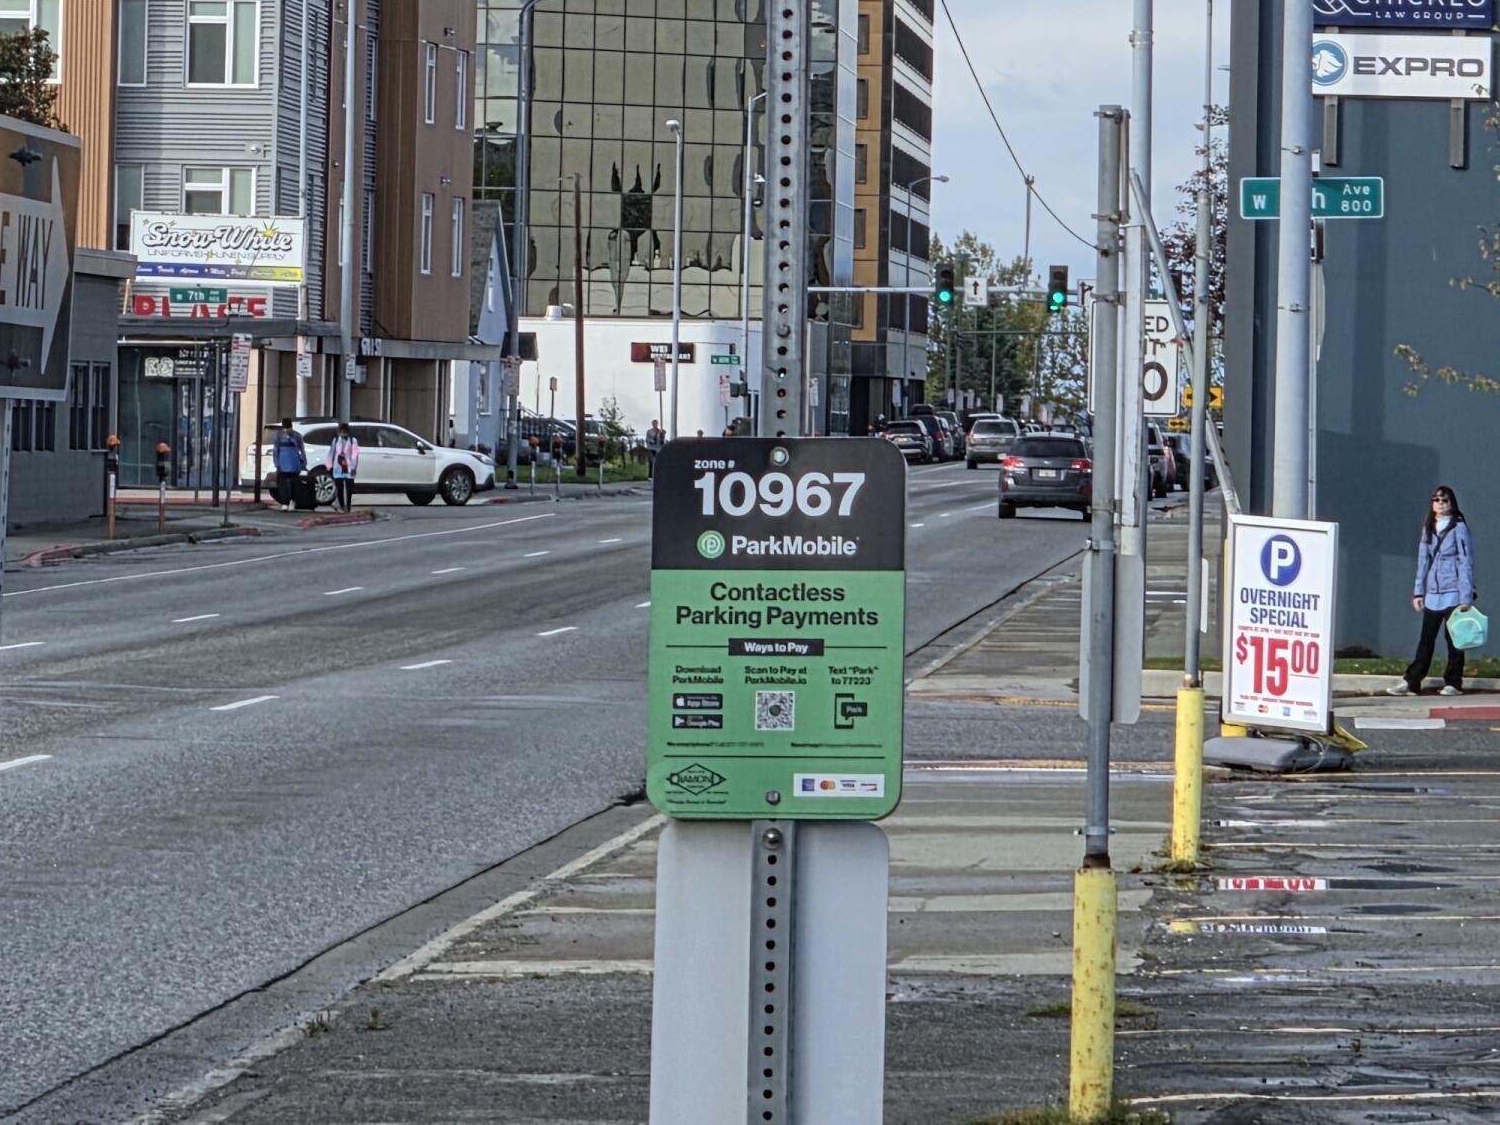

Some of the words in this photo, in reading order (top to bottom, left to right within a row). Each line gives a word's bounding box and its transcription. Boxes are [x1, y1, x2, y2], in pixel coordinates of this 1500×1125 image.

[1375, 11, 1406, 19] LAW
[1413, 12, 1464, 20] GROUP
[1353, 56, 1485, 78] EXPRO
[1252, 195, 1267, 210] W
[1342, 184, 1371, 195] Ave
[1341, 200, 1372, 212] 800
[142, 221, 214, 249] Snow
[214, 225, 293, 252] White
[15, 214, 53, 311] WAY
[187, 290, 205, 302] 7th
[694, 460, 726, 469] zone
[694, 471, 866, 517] 10967
[731, 535, 858, 556] ParkMobile
[1270, 540, 1295, 580] P
[710, 582, 845, 602] Contactless
[1240, 587, 1321, 612] OVERNIGHT
[676, 606, 761, 629] Parking
[766, 606, 879, 629] Payments
[1250, 607, 1309, 629] SPECIAL
[744, 641, 774, 654] Ways
[775, 642, 786, 653] to
[787, 642, 809, 655] Pay
[672, 675, 724, 684] ParkMobile
[675, 665, 722, 674] Download
[744, 666, 768, 675] Scan
[769, 666, 779, 675] to
[780, 666, 797, 677] Pay
[828, 666, 847, 675] Text
[831, 677, 841, 685] to
